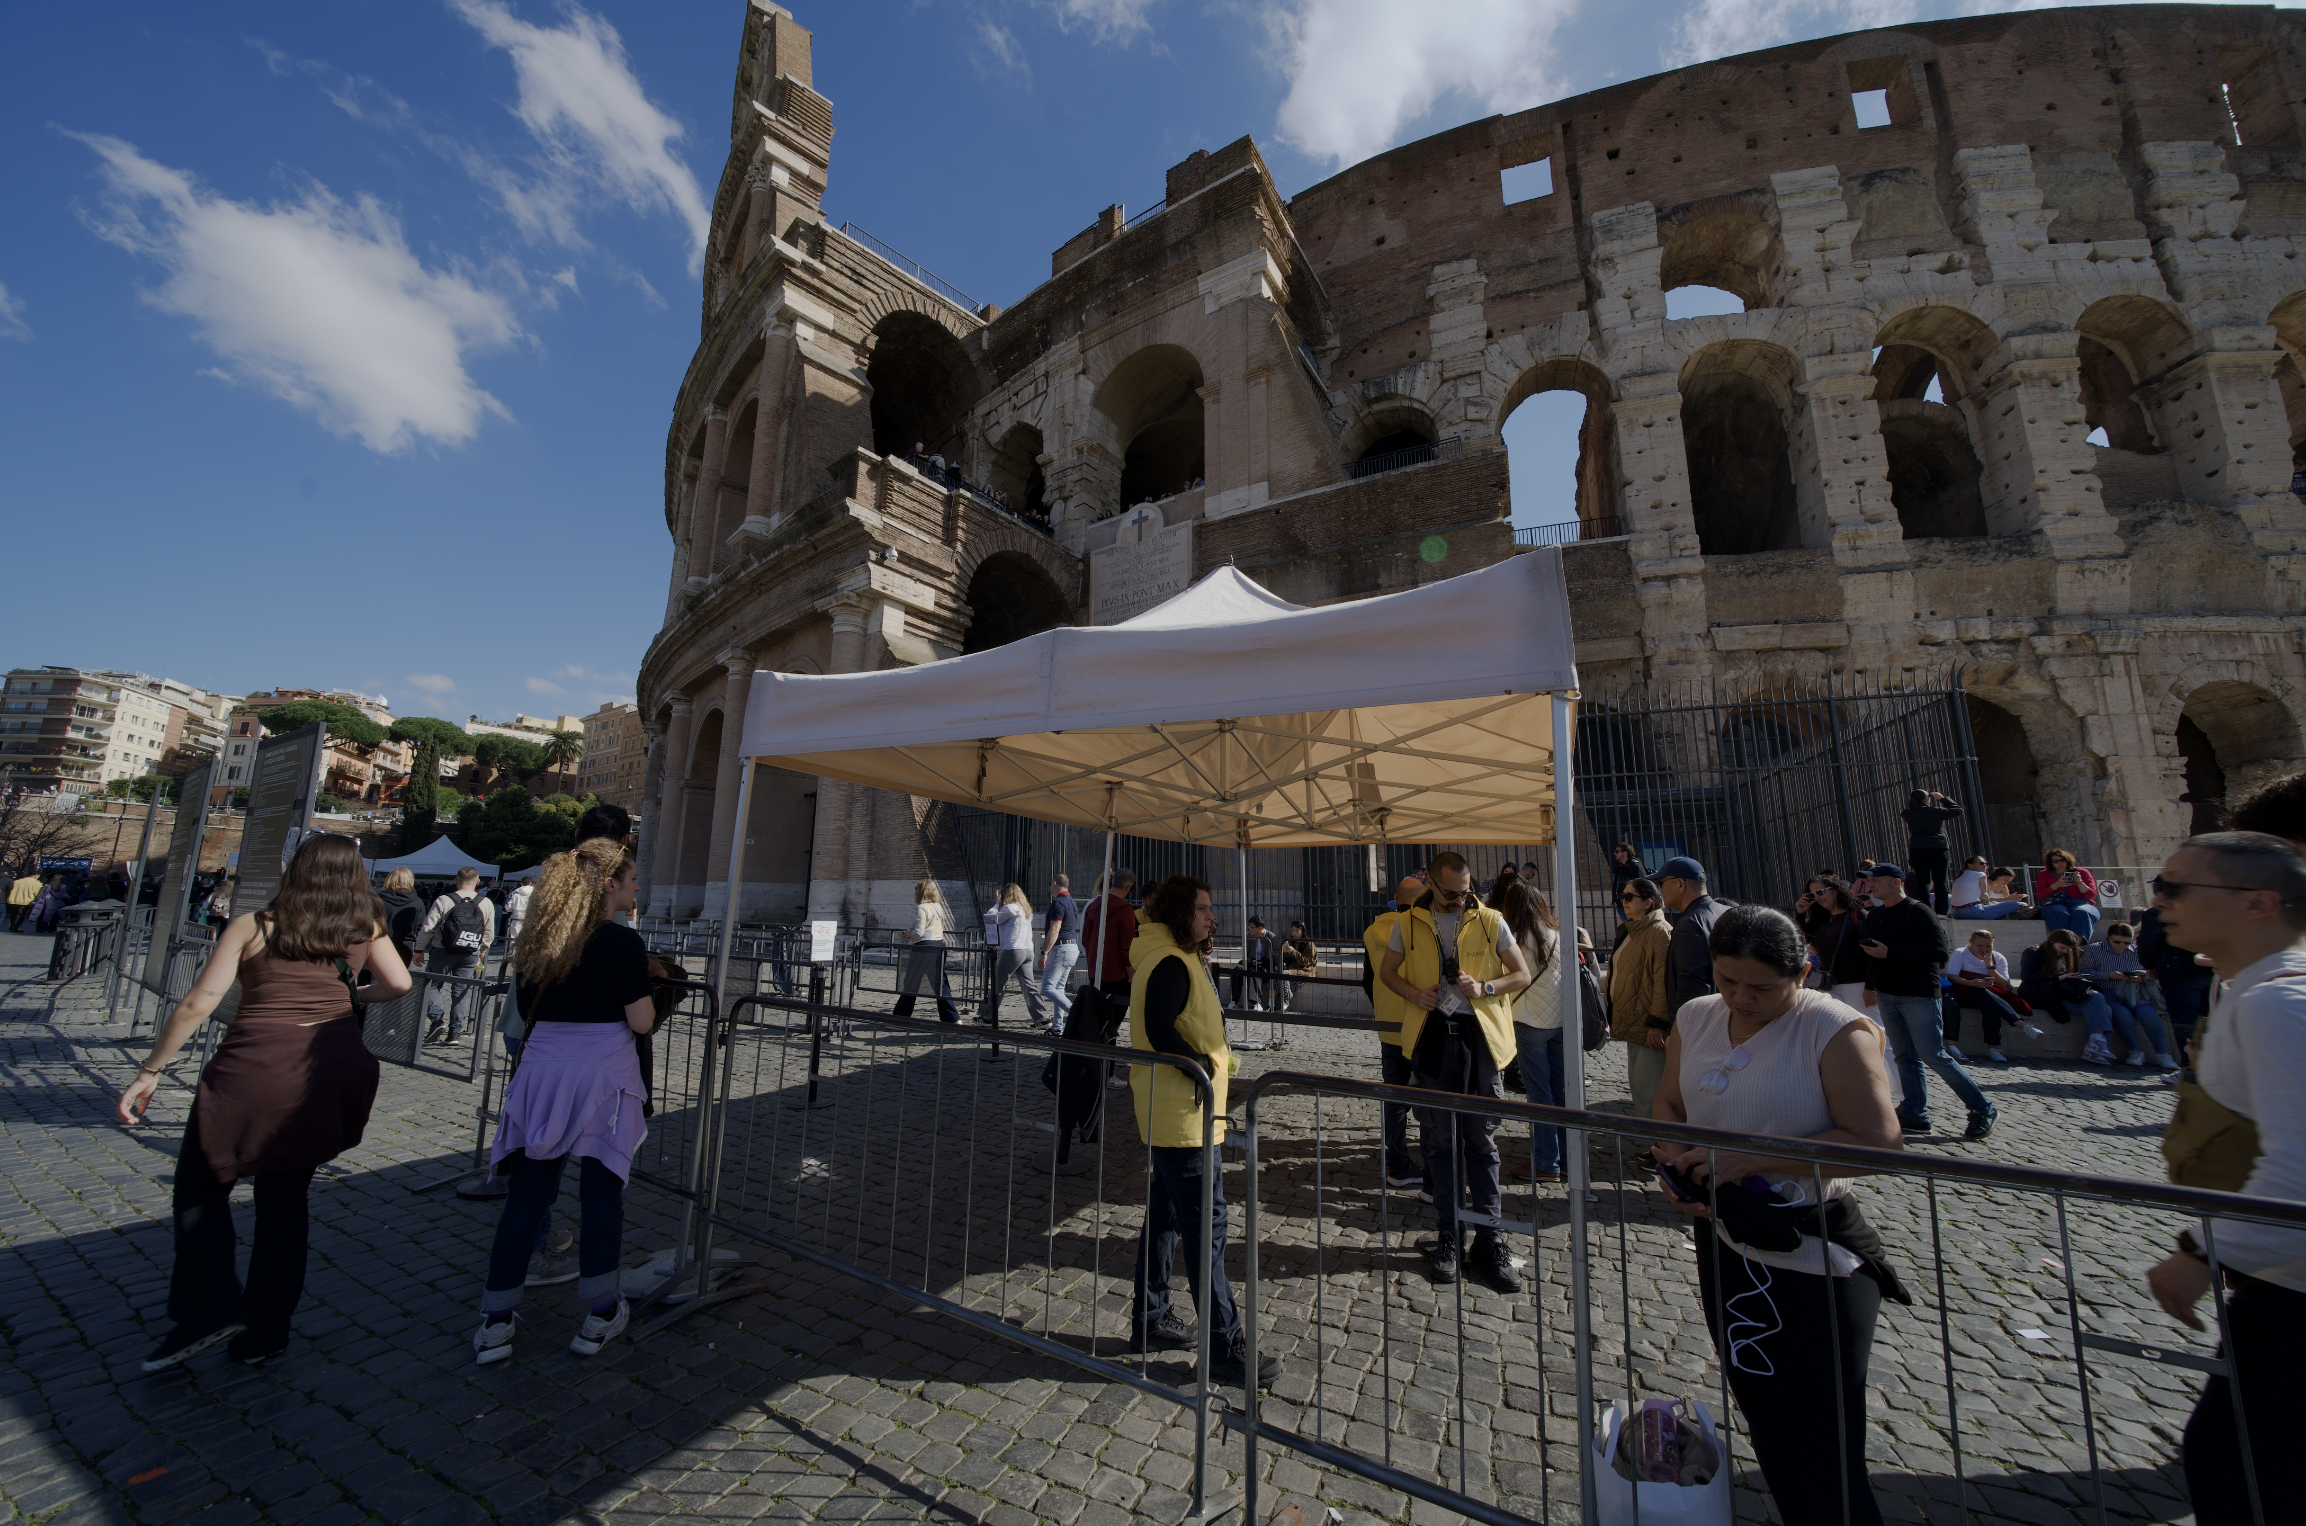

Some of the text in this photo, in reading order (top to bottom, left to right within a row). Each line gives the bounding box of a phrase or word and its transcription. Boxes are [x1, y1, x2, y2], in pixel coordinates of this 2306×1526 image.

[1132, 586, 1154, 600] PONT
[1157, 579, 1179, 593] MAX
[459, 930, 482, 942] IGU
[455, 938, 479, 948] ana
